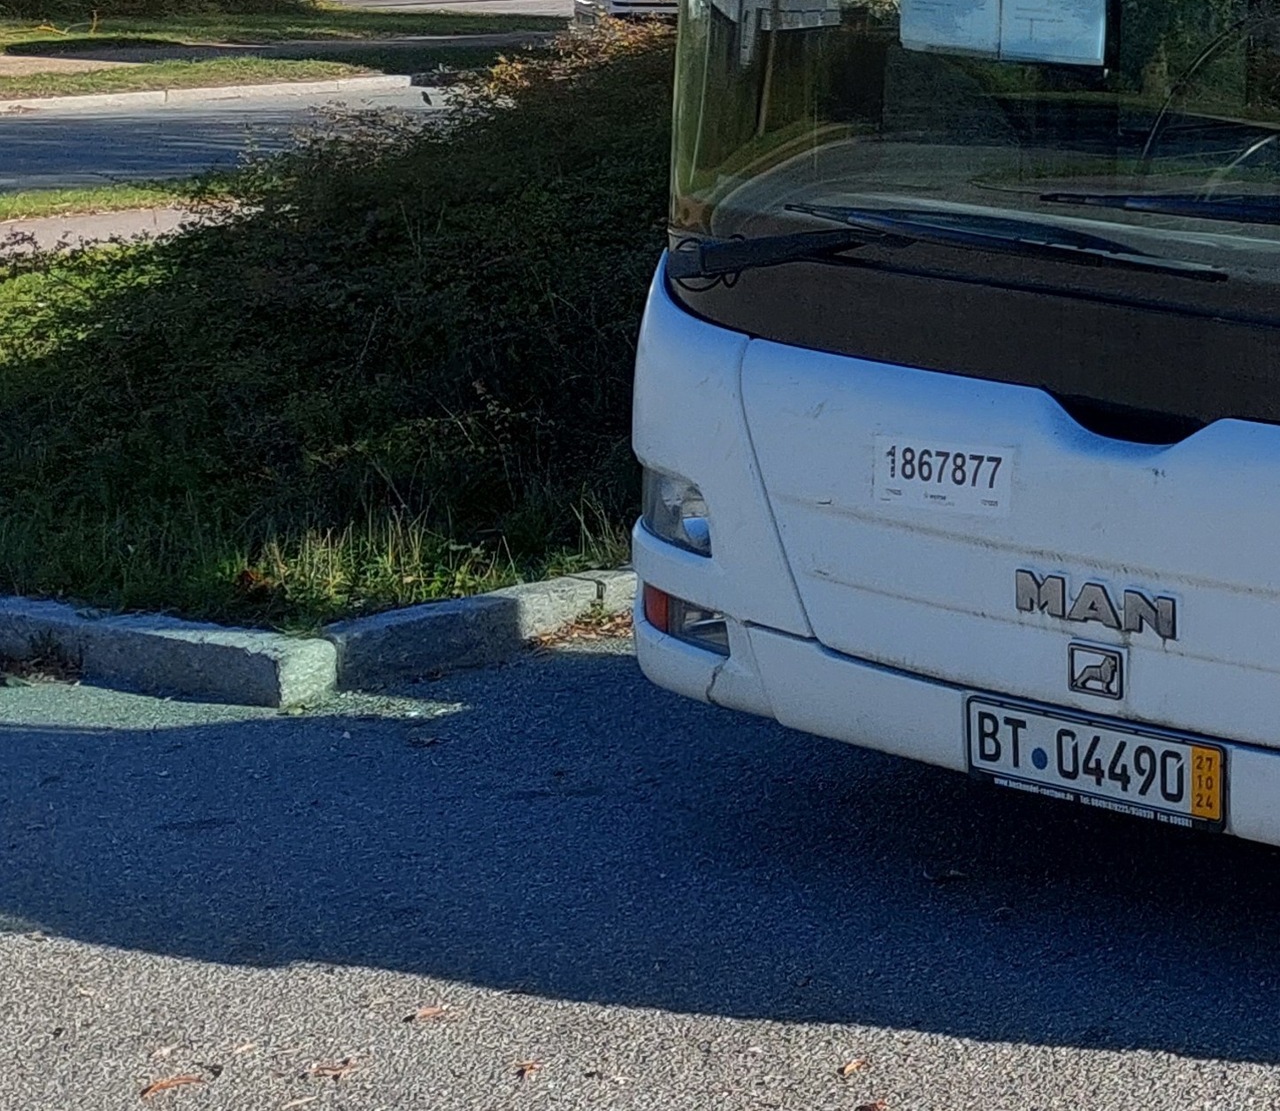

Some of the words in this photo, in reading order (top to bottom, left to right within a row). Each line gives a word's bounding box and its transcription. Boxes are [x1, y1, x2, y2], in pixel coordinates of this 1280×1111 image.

[886, 445, 1003, 489] 1867877
[1015, 568, 1178, 640] MAN
[978, 711, 1027, 769] BT
[1056, 728, 1185, 803] 04490
[1196, 755, 1213, 770] 27
[1197, 774, 1213, 790] 10
[1195, 792, 1214, 810] 24
